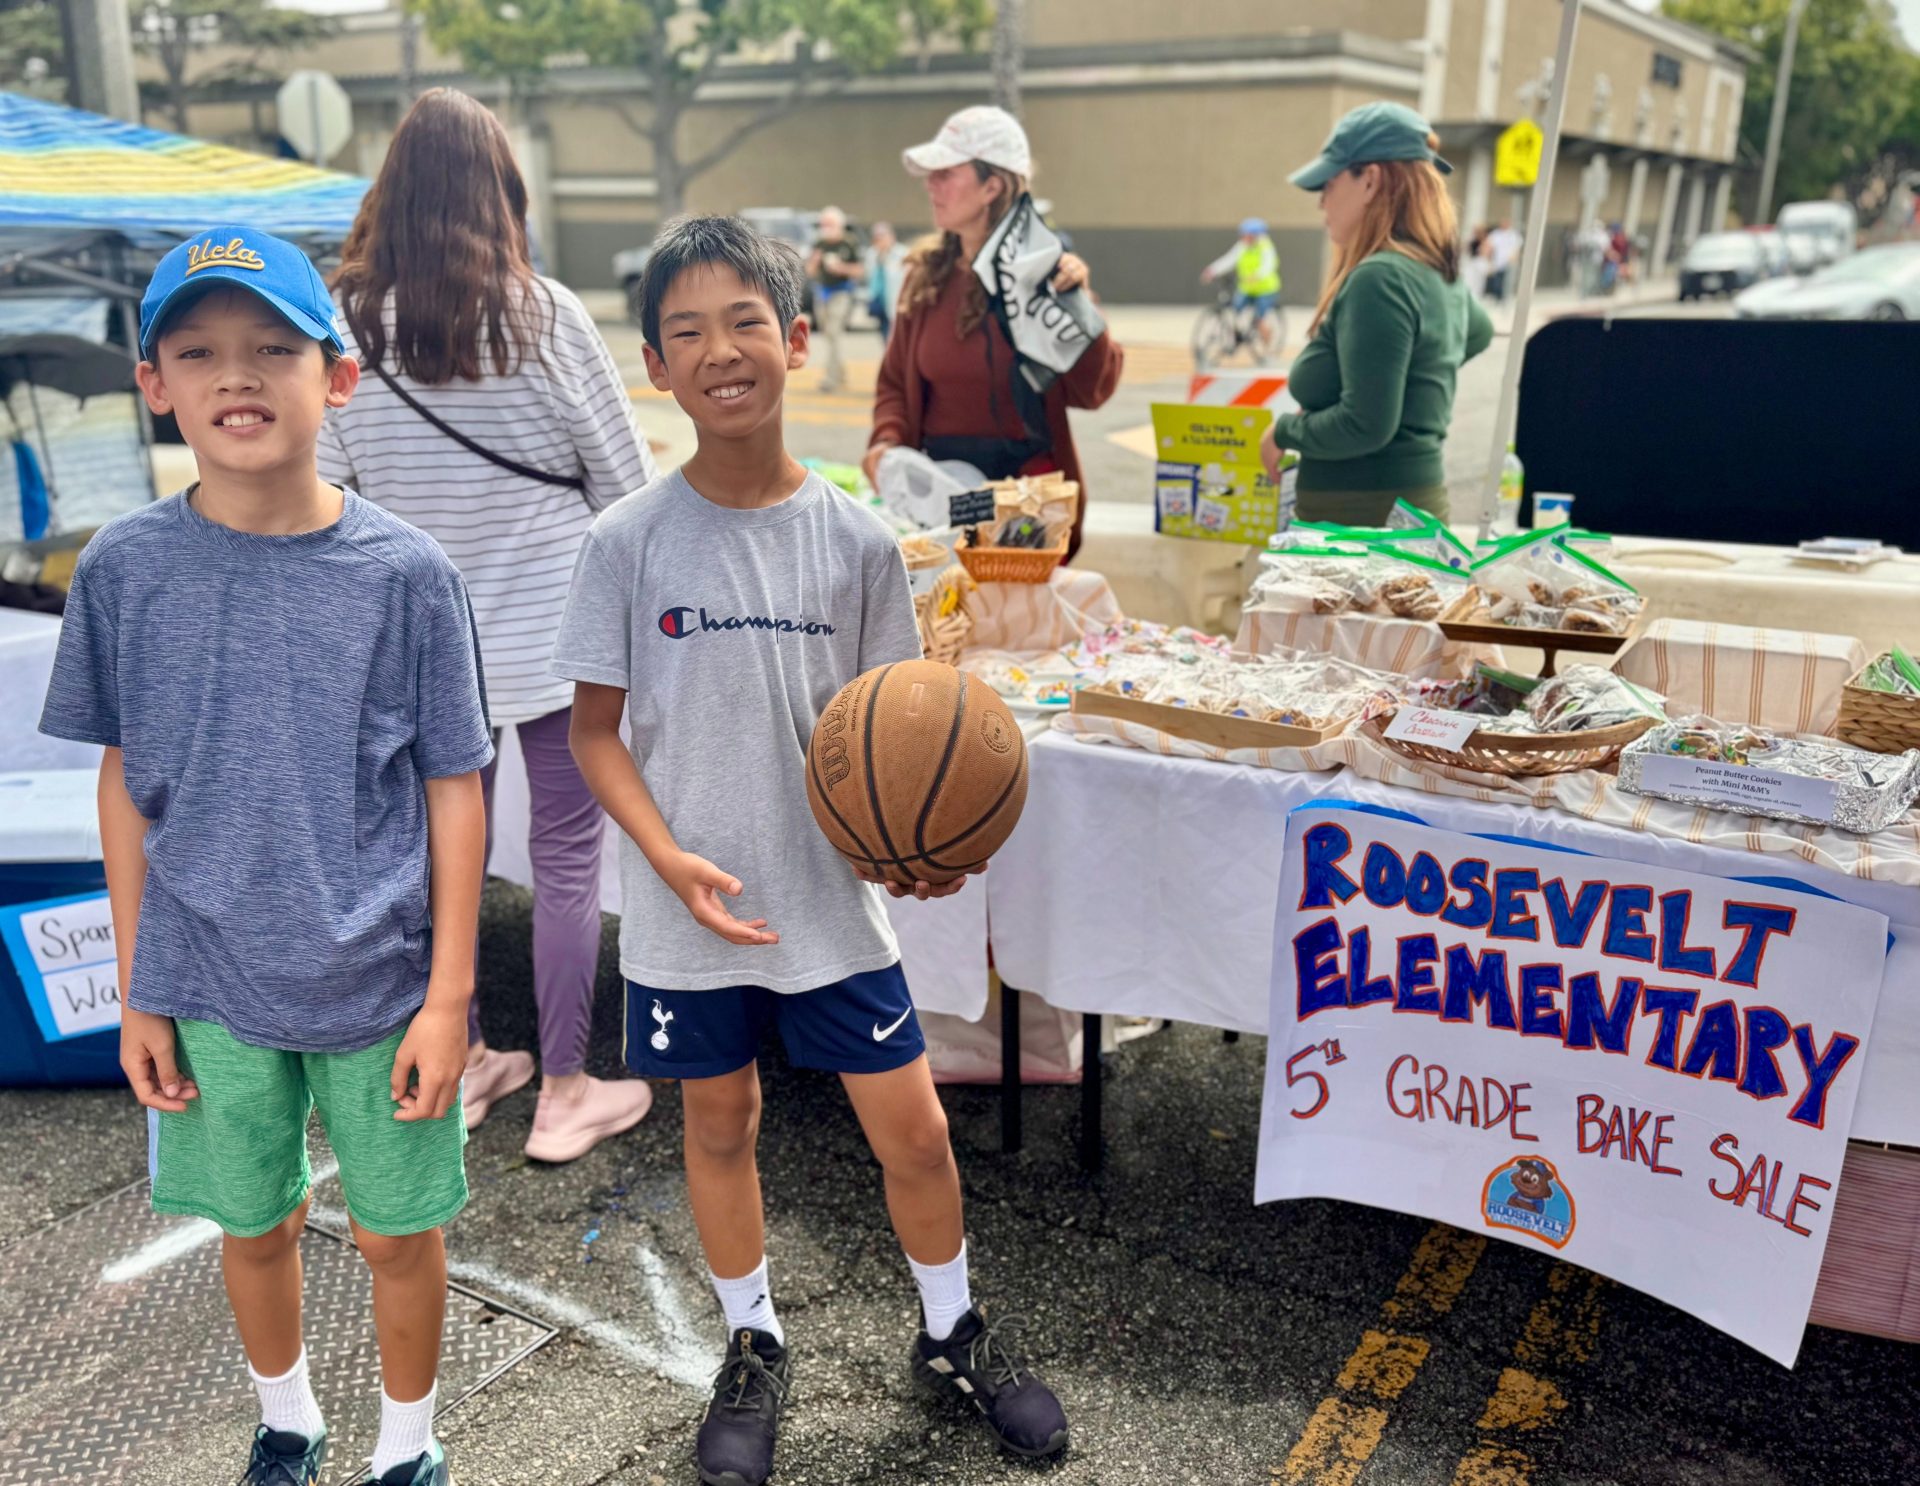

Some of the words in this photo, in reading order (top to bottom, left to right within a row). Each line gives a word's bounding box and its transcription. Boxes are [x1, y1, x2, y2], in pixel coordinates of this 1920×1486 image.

[658, 606, 837, 644] Champion
[1695, 766, 1722, 776] Peanut
[1723, 770, 1749, 781] Butter
[1750, 774, 1782, 786] Cookies
[1702, 778, 1719, 786] with
[1720, 780, 1740, 790] Mini
[1741, 784, 1771, 795] M&M's
[1296, 822, 1797, 989] ROOSEVELT
[40, 917, 114, 960] Spar
[60, 976, 122, 1015] Wa
[1292, 916, 1860, 1130] ELEMENTARY
[1386, 1054, 1540, 1142] GRADE
[1576, 1094, 1683, 1177] BAKE
[1708, 1133, 1831, 1238] SALE
[1487, 1201, 1567, 1237] ROOSEVELT
